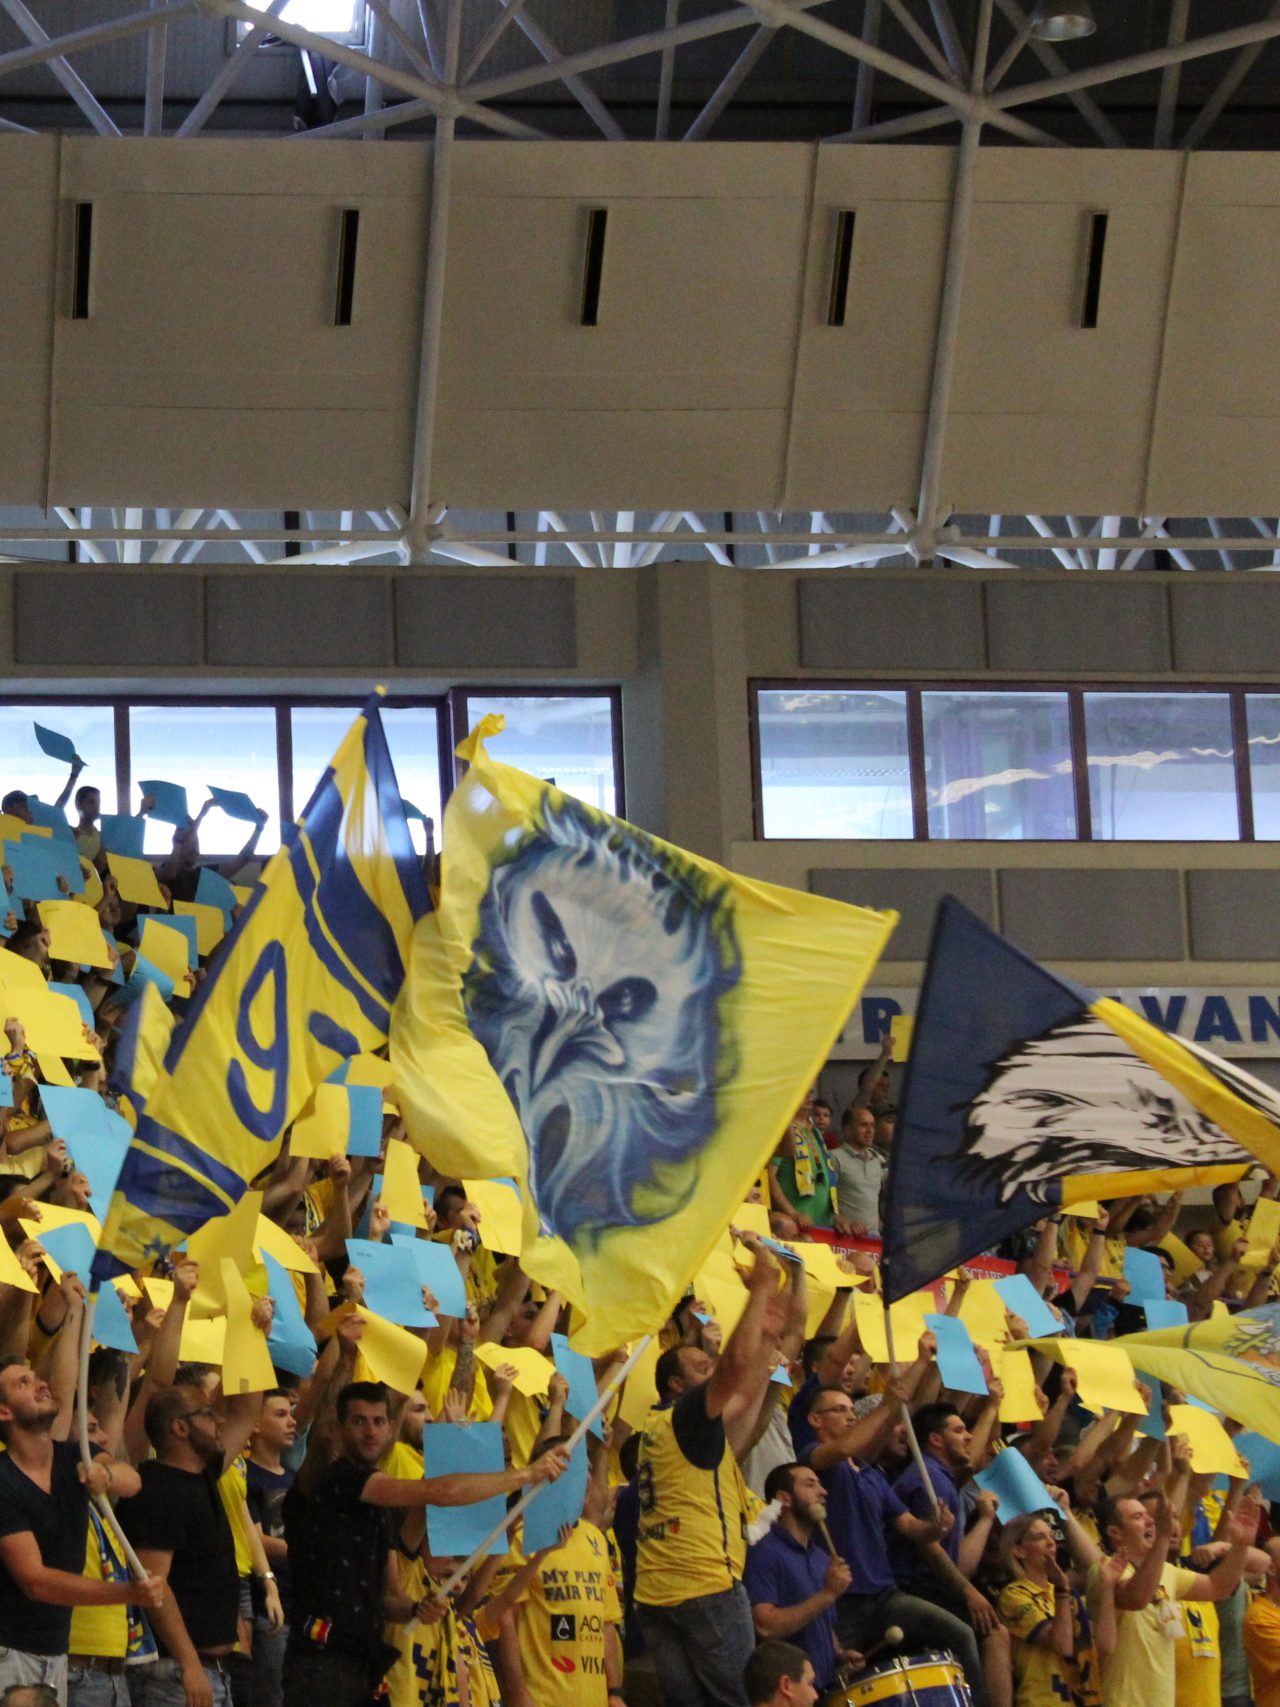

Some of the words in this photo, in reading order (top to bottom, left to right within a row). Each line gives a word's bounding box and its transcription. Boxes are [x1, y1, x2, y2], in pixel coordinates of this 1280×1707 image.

[1104, 995, 1280, 1042] VAN
[543, 1585, 582, 1601] FAIR
[579, 1615, 604, 1633] AQ
